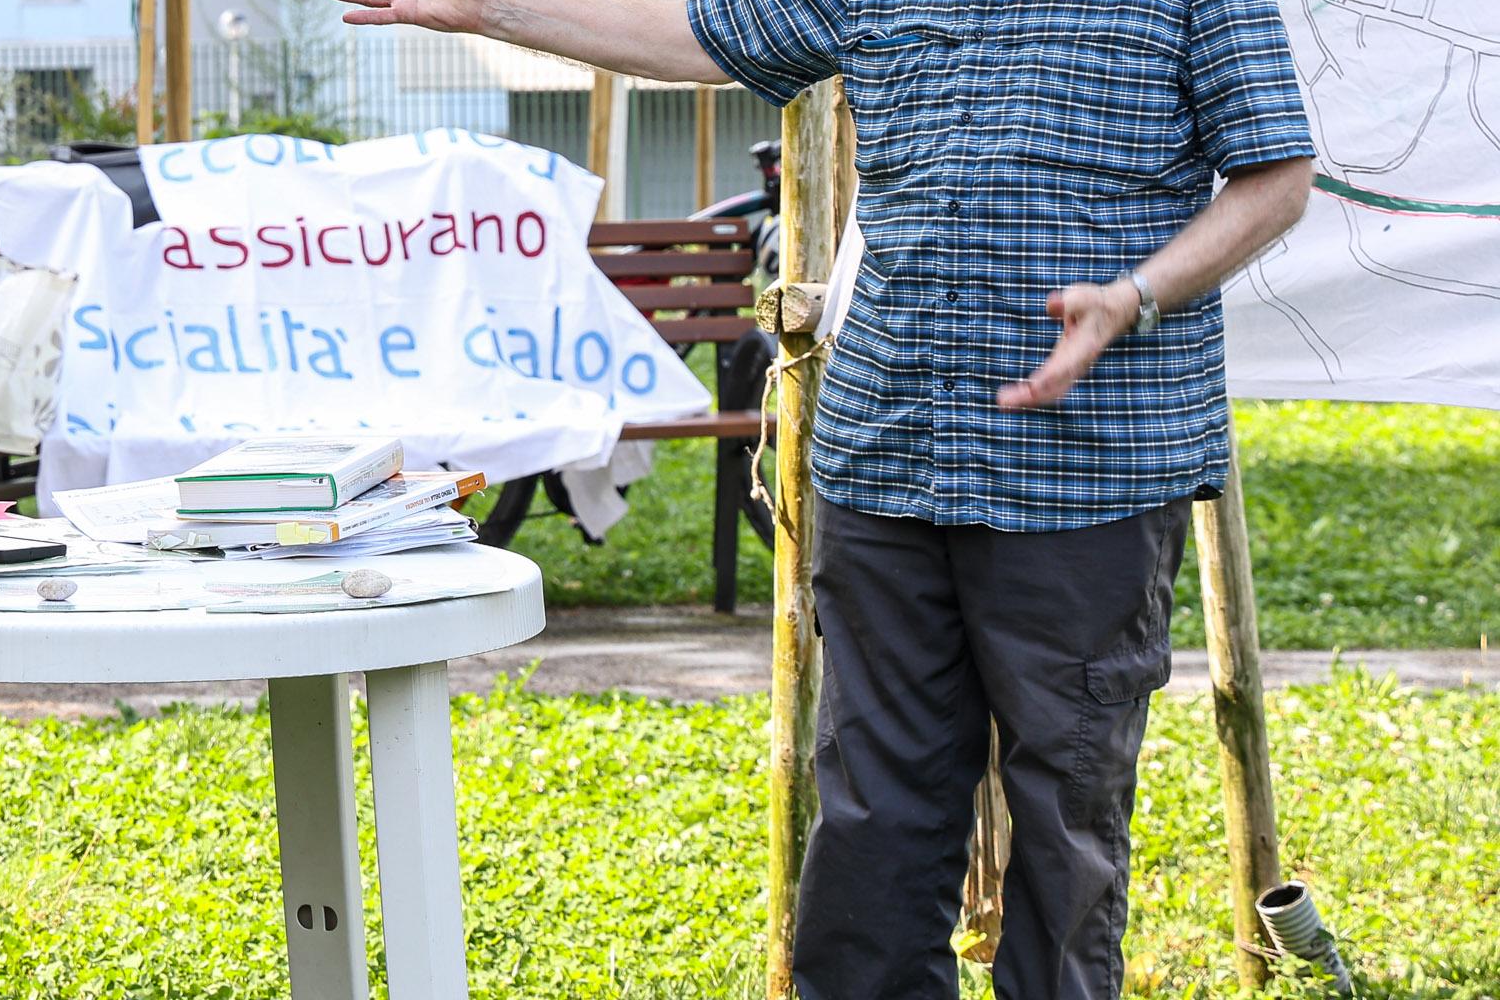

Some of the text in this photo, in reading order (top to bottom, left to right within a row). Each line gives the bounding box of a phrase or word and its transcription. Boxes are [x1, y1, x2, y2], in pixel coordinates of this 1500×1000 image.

[162, 210, 547, 272] assicurano
[73, 303, 354, 381] Scialità
[380, 323, 422, 379] e
